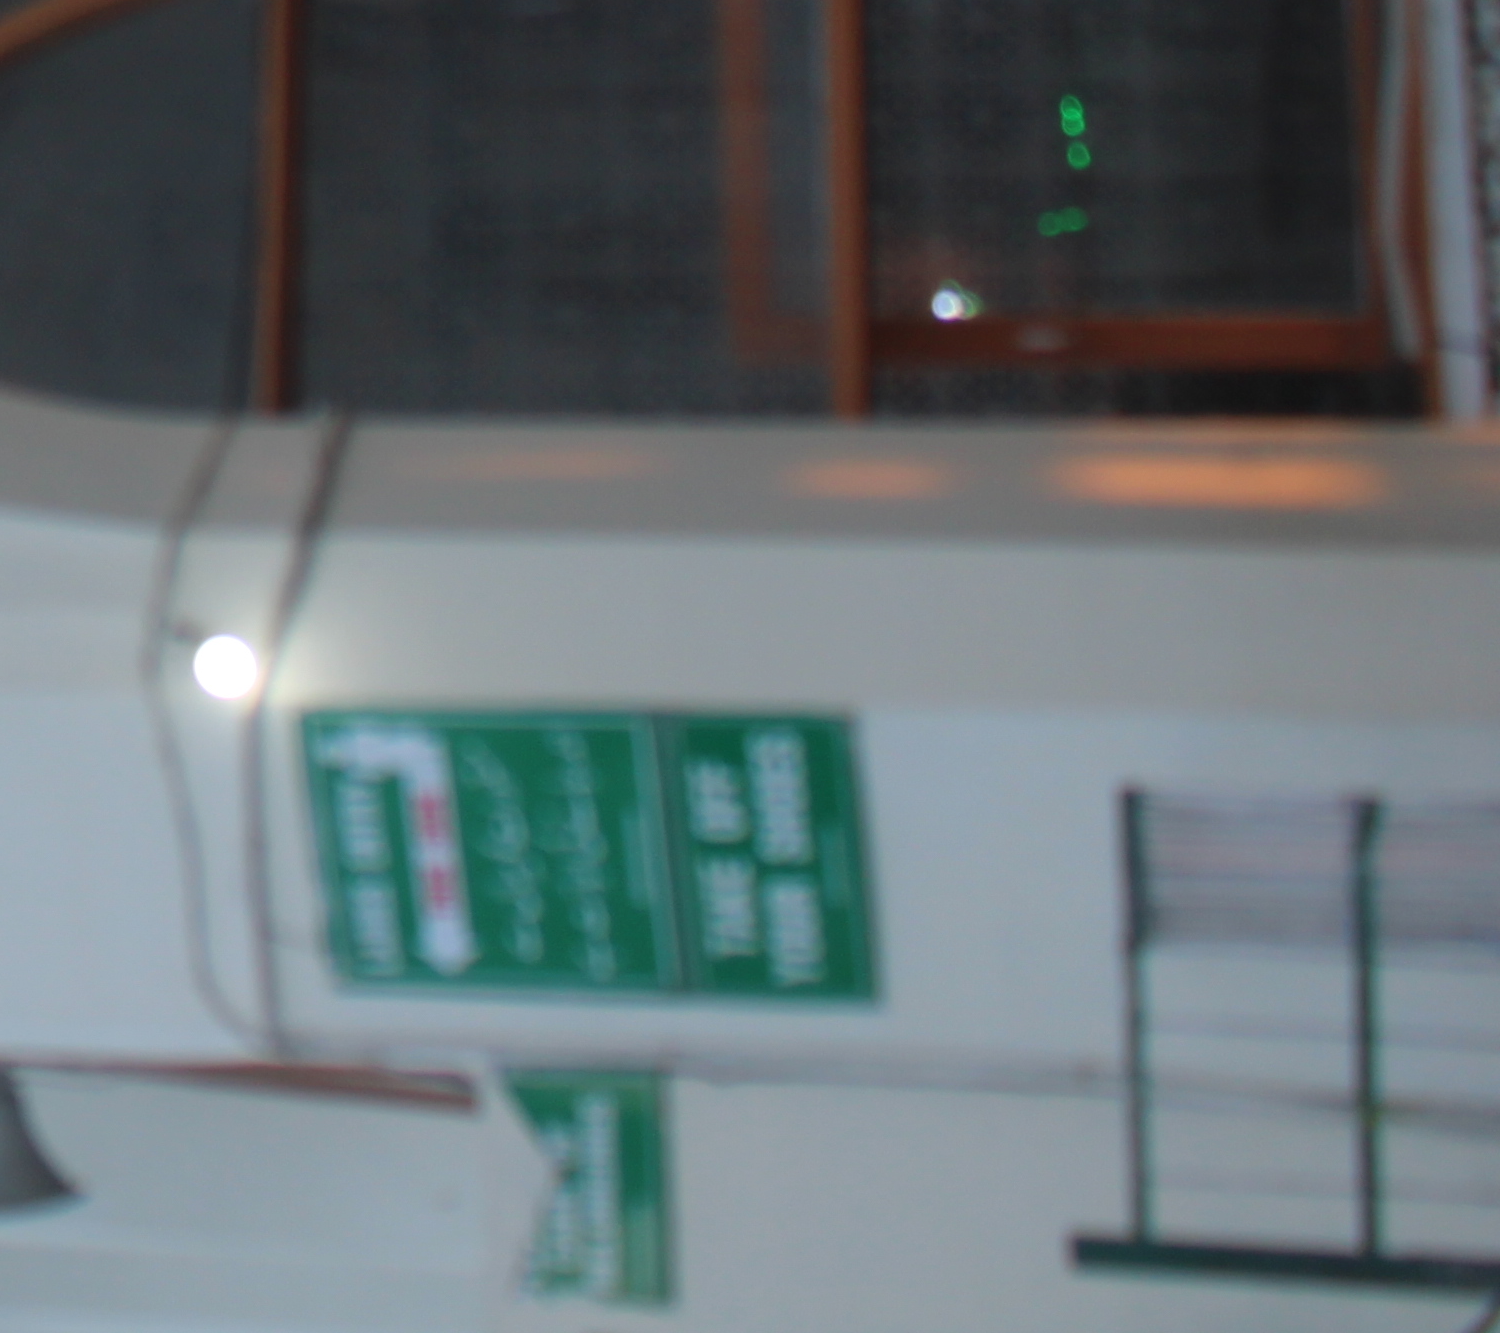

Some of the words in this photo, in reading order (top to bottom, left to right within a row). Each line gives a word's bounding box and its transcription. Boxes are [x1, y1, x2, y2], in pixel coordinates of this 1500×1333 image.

[686, 760, 749, 842] OFF
[745, 732, 814, 863] SHOES
[698, 858, 760, 958] TAKE
[764, 876, 825, 985] YOUR
